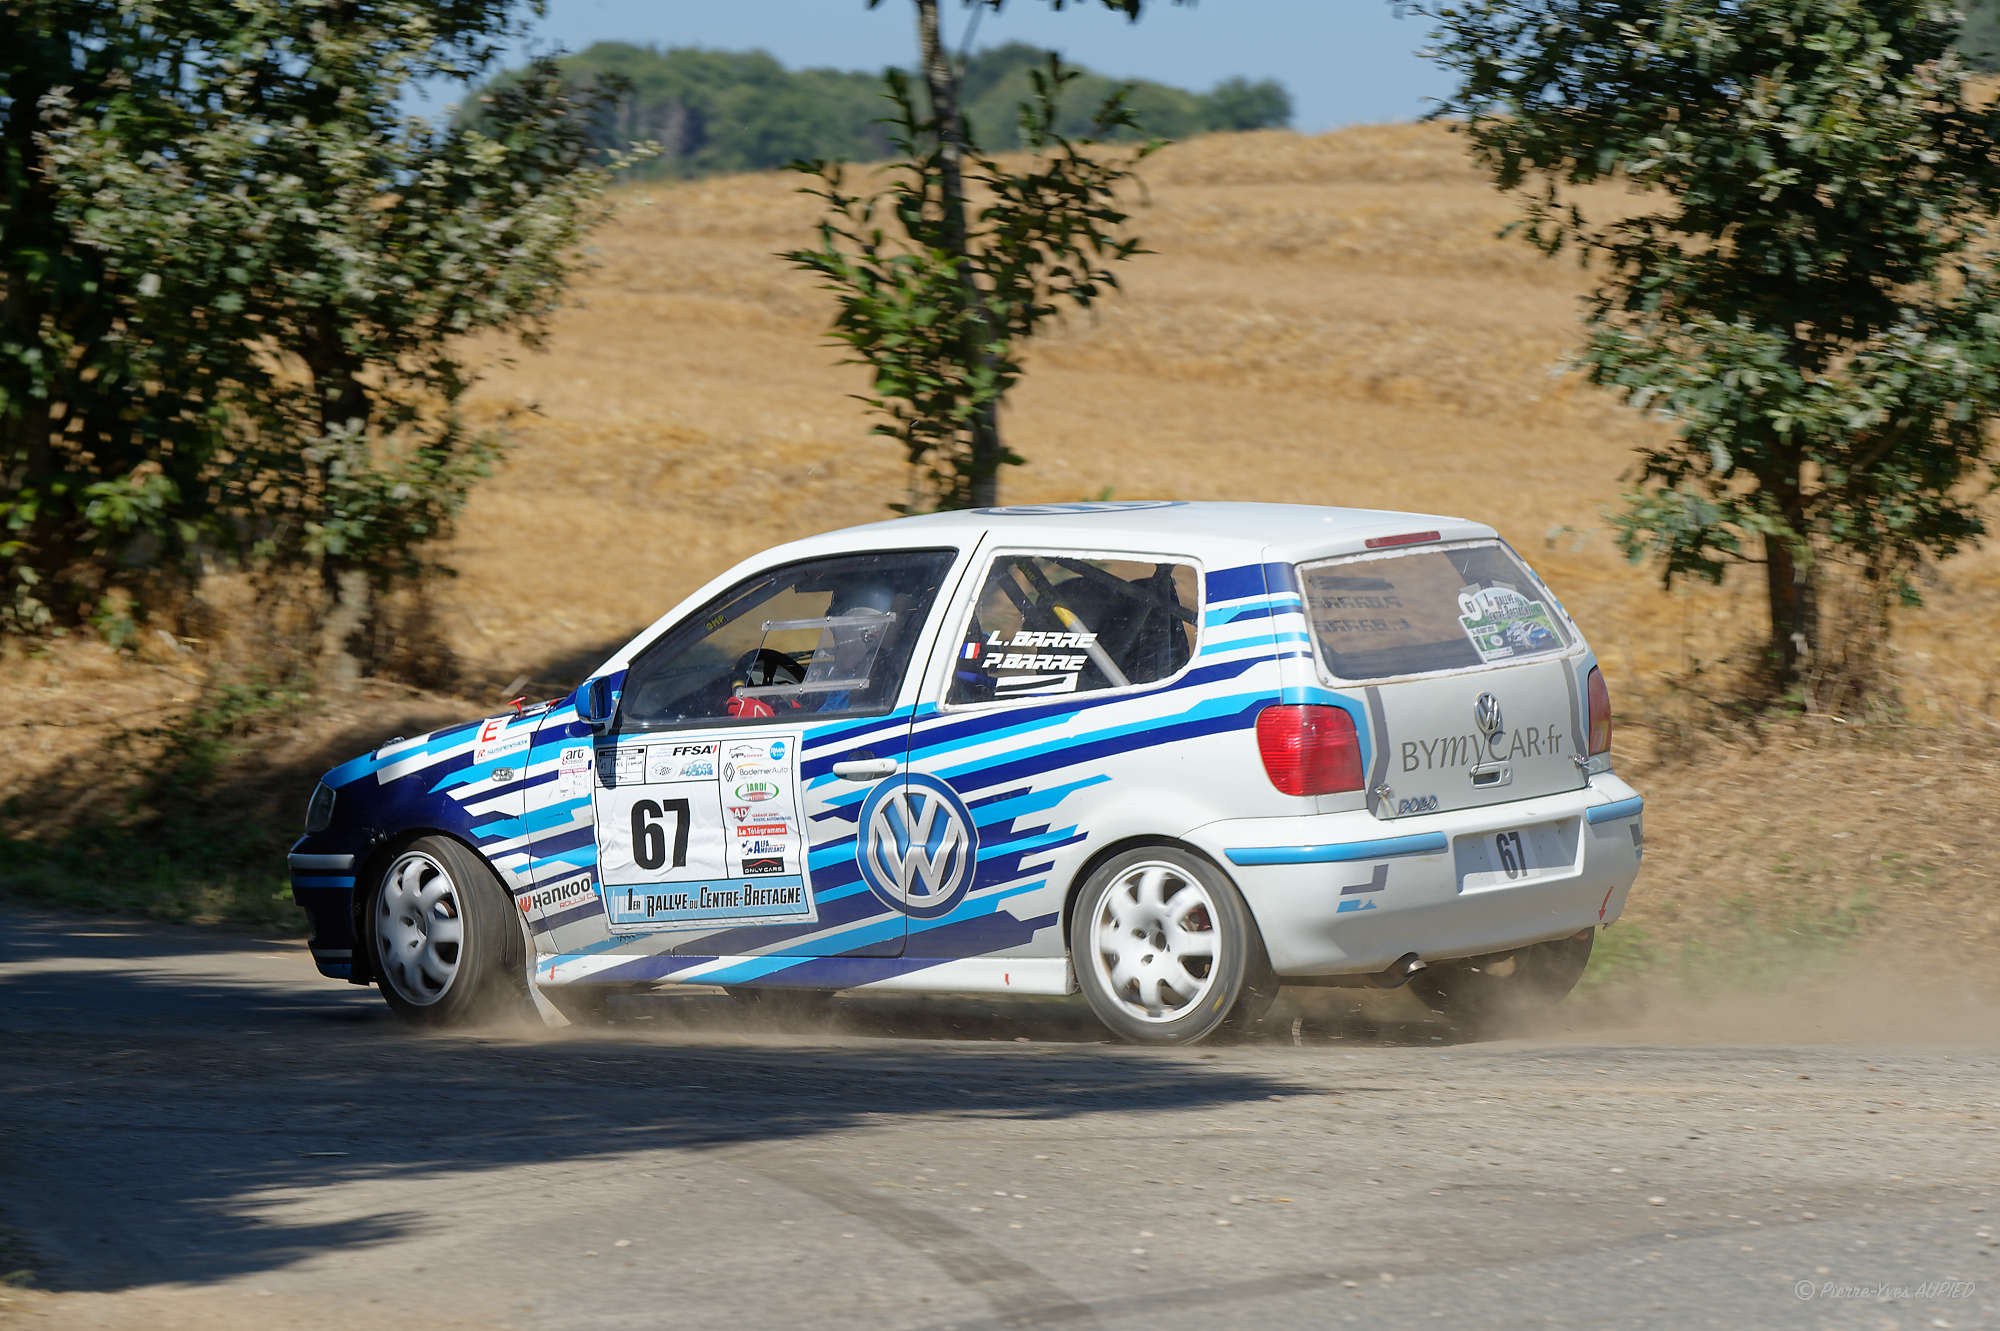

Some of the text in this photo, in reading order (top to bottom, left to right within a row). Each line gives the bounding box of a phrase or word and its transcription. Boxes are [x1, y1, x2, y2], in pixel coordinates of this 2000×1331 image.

[482, 720, 503, 742] E
[566, 749, 583, 760] art
[673, 745, 711, 756] FFSA
[734, 808, 748, 817] AD
[631, 798, 690, 870] 67
[1496, 831, 1528, 879] 67
[647, 894, 688, 917] RALLYE
[700, 884, 801, 908] CENTRE-BRETAGNE
